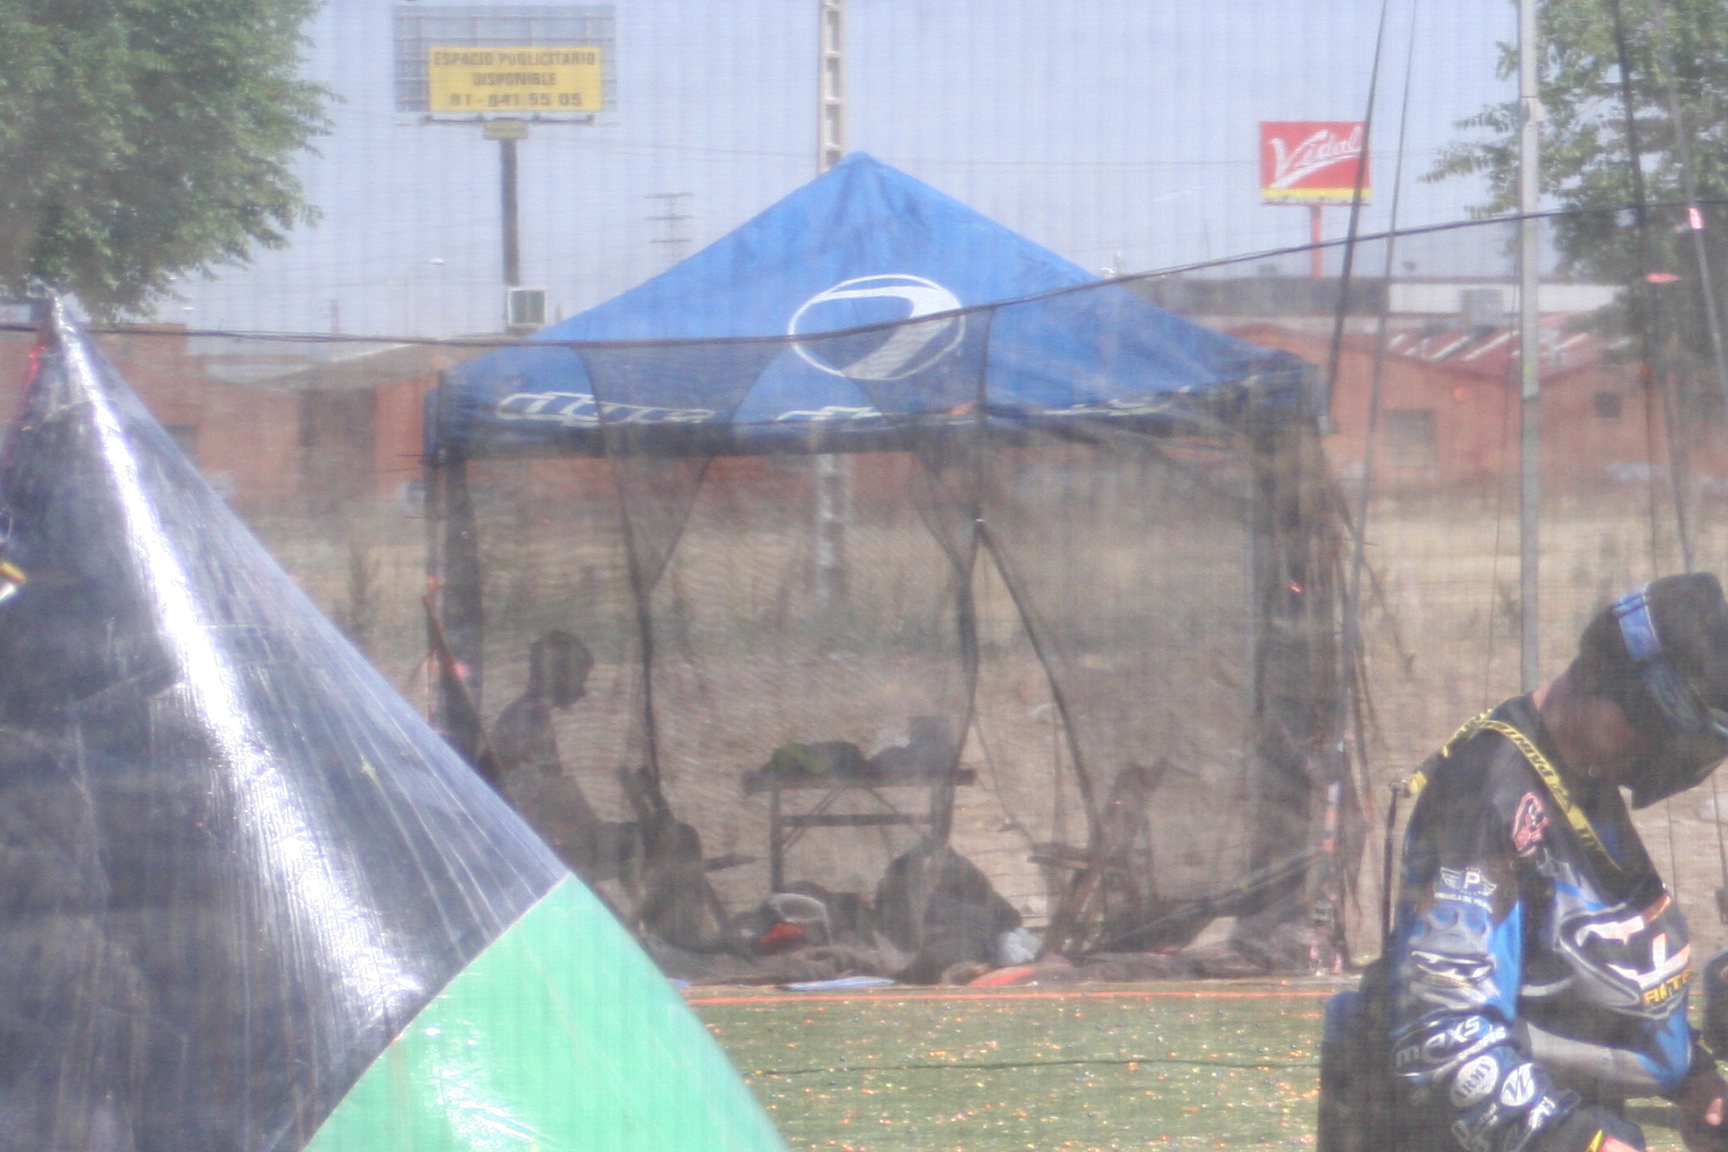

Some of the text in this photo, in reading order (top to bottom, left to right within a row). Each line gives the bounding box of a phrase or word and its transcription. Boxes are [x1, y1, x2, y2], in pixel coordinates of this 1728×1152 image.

[434, 52, 595, 65] ESPACIO PUBLICITARIO
[472, 72, 557, 86] DISPONIBLE
